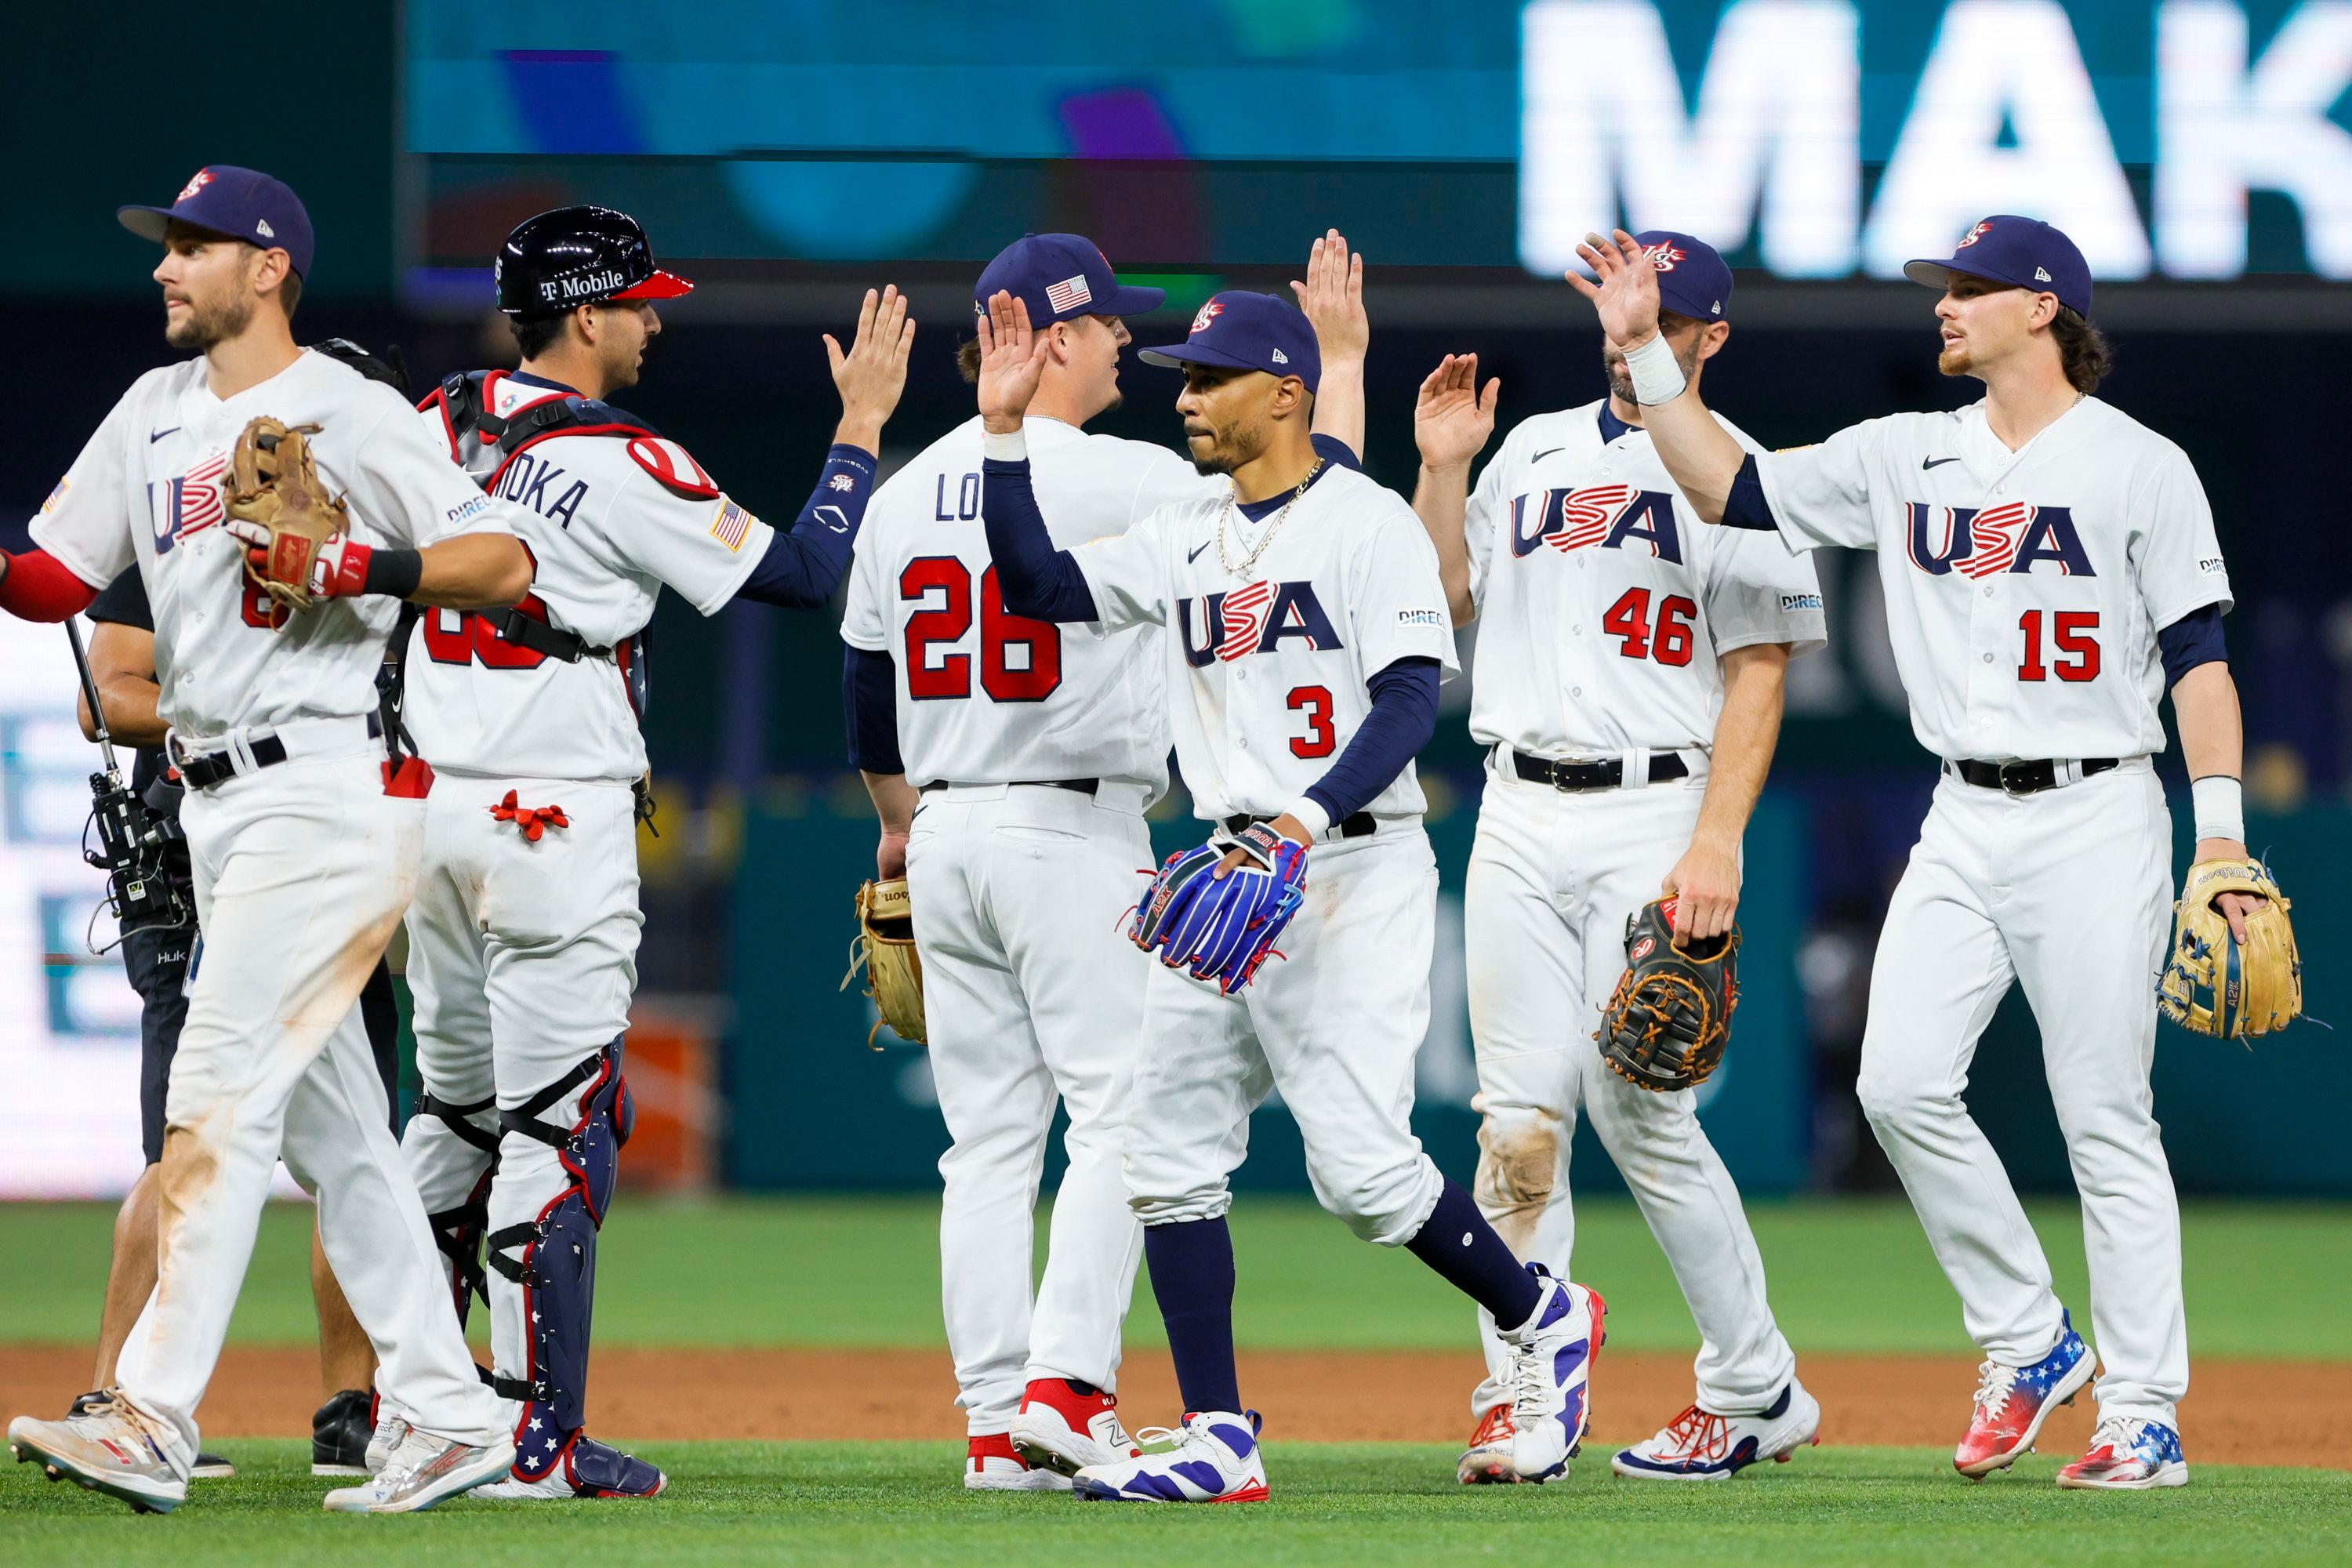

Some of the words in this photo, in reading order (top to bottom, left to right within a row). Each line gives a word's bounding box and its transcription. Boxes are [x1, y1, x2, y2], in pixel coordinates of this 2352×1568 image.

[1518, 0, 2352, 280] MAK
[561, 270, 624, 298] Mobile
[147, 451, 228, 555] US
[935, 473, 980, 521] LO
[1510, 484, 1683, 566] USA
[1905, 501, 2097, 580] USA
[899, 555, 1062, 702] 26
[1175, 579, 1344, 669] USA
[1603, 586, 1697, 667] 46
[2018, 609, 2100, 682] 15
[1287, 684, 1336, 760] 3
[1152, 884, 1173, 918] A2K
[2227, 979, 2240, 1007] A2K
